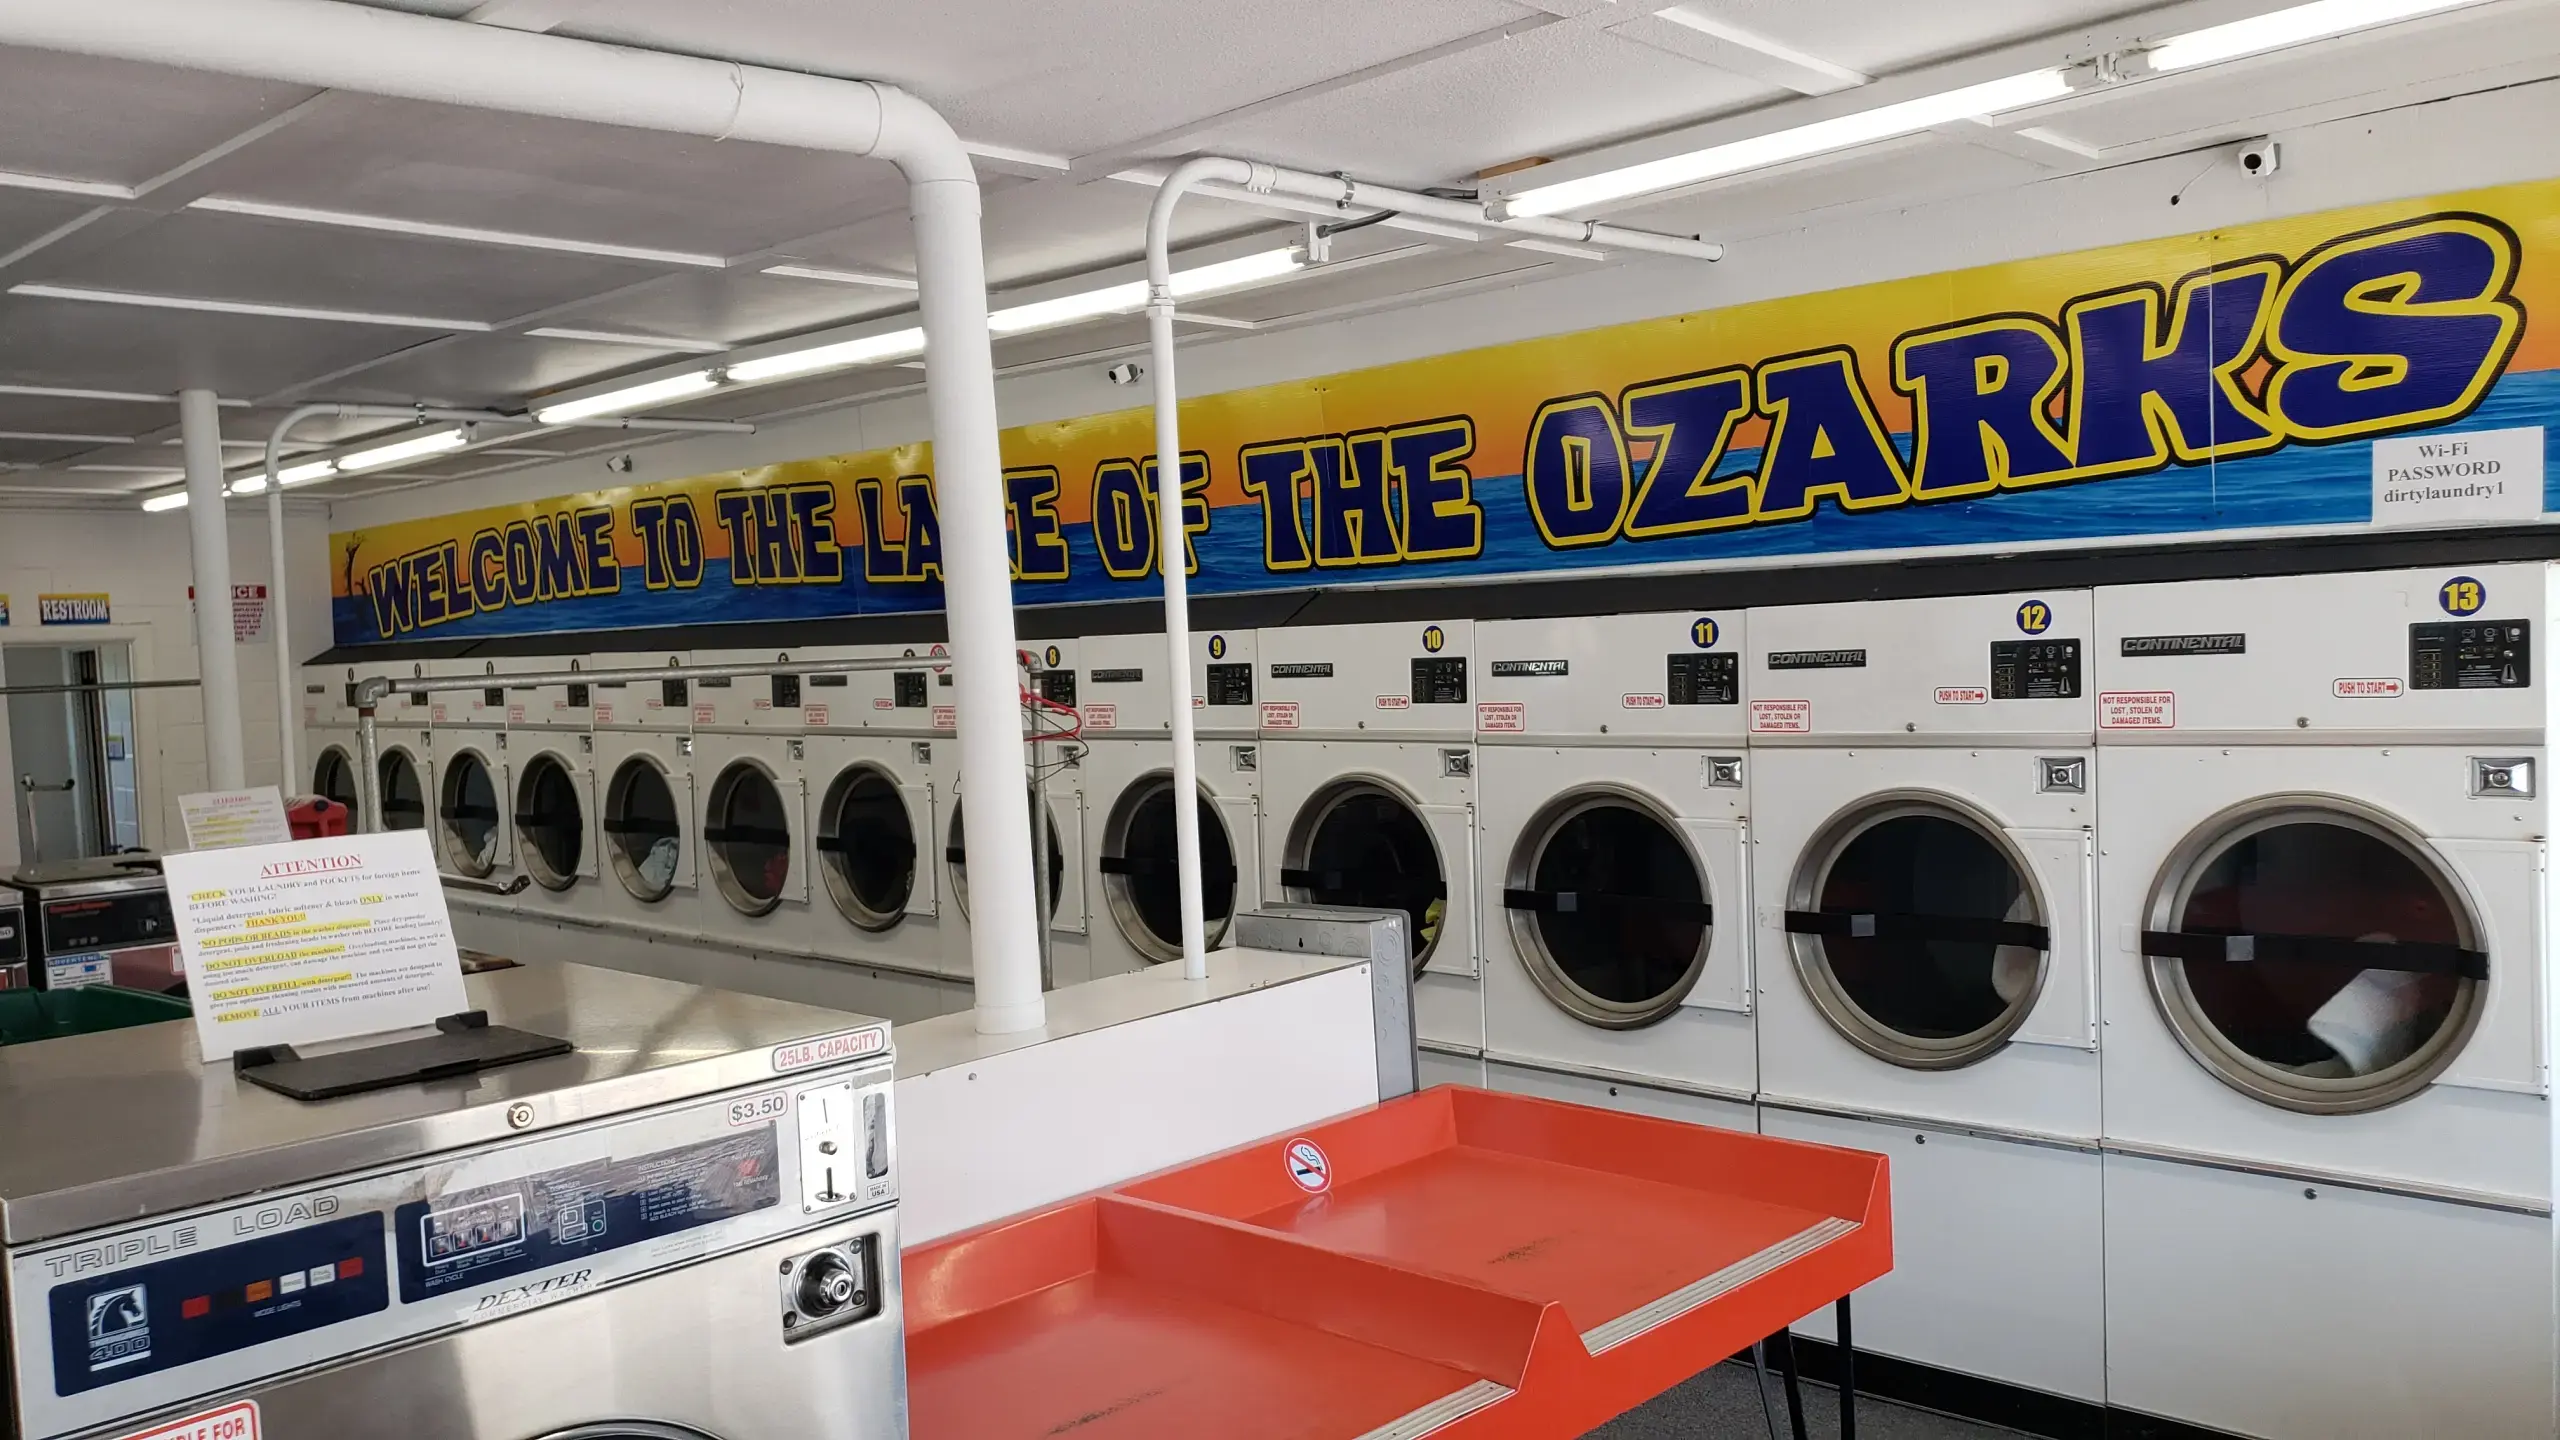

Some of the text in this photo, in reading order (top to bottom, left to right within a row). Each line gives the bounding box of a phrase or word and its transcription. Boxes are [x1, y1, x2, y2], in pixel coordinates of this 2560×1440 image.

[367, 212, 2526, 638] WELCOME TO THE LAE OF THE OZARKS
[2419, 442, 2468, 458] Wi-Fi
[2388, 460, 2501, 482] PASSWORD
[2384, 481, 2504, 504] dirtylaundry1
[2444, 582, 2479, 611] 13
[41, 599, 108, 620] RESTROOM
[2020, 605, 2046, 630] 12
[1424, 629, 1442, 649] 10
[1695, 622, 1713, 644] 11
[1213, 638, 1221, 656] 9
[2123, 636, 2244, 650] CONTINENTAL
[1493, 662, 1566, 672] CONTINENTAL
[1769, 651, 1864, 664] CONTINENTAL
[1272, 665, 1331, 674] CONTINENTAL
[1939, 690, 1976, 701] PUSH TO START
[2339, 682, 2386, 694] PUSH TO START
[2103, 696, 2171, 704] NOT RESPONSIBLE FOR
[2130, 706, 2153, 715] STOLEN
[2155, 706, 2163, 714] OR
[2112, 716, 2162, 725] DAMAGED ITEMS.
[261, 854, 362, 877] ATTENTION
[257, 881, 301, 892] LAUNDRY
[333, 897, 359, 907] bleach
[359, 894, 384, 904] ONLY
[245, 915, 280, 927] THANK
[261, 1006, 281, 1016] ALL
[281, 1001, 309, 1012] YOUR
[310, 996, 339, 1008] ITEMS
[780, 1032, 877, 1067] 25LB. CAPACITY
[731, 1096, 784, 1122] $3.50
[638, 1157, 676, 1171] INSTRUCTIONS
[872, 1189, 885, 1197] USA
[44, 1195, 340, 1278] TRIPLE LOAD
[425, 1273, 464, 1288] WASH CYCLE
[473, 1268, 591, 1313] DEXTER
[473, 1297, 544, 1321] COMMERCIAL
[89, 1334, 151, 1360] 400
[213, 1417, 245, 1439] FOR
